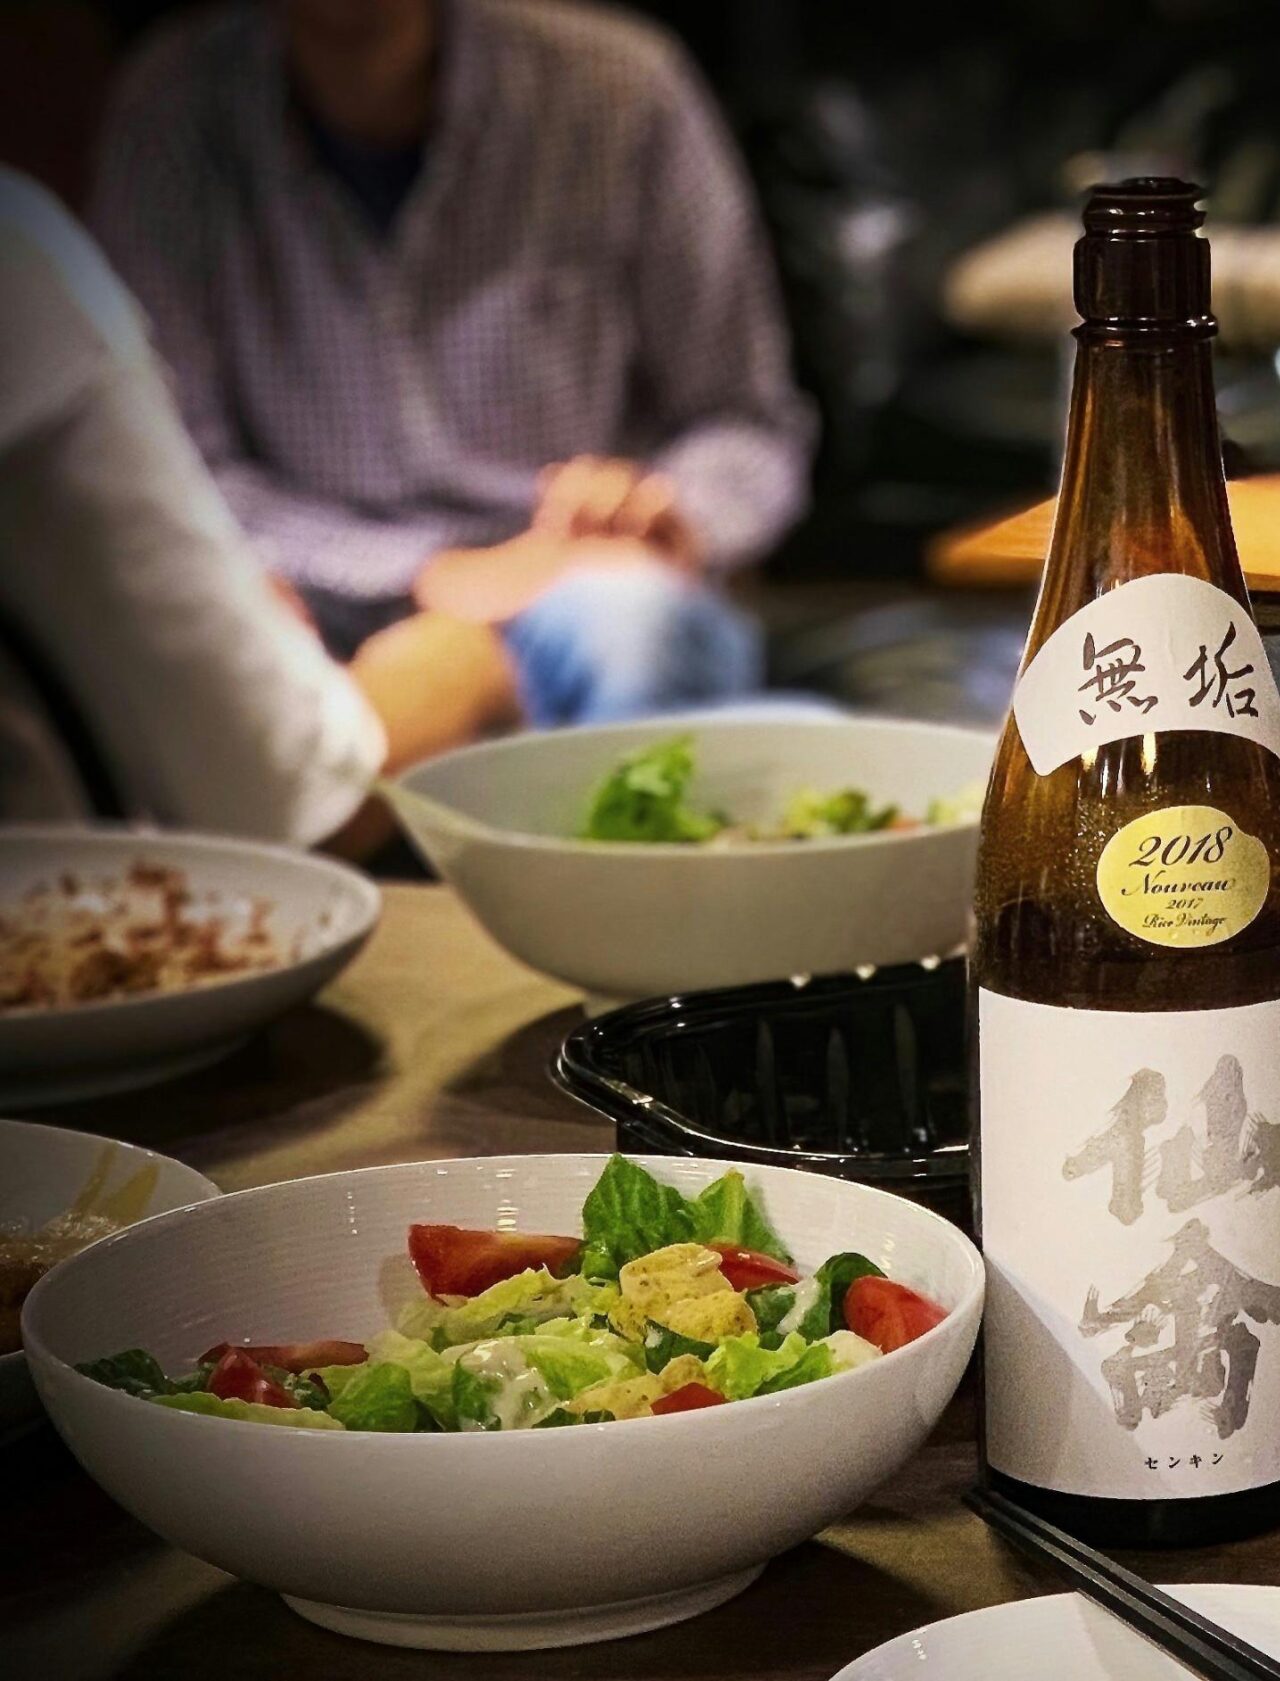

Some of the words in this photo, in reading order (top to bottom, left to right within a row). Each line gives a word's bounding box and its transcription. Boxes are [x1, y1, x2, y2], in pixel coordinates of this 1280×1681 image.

[1077, 621, 1260, 726] 無垢
[1128, 826, 1234, 868] 2018
[1121, 870, 1236, 897] Nouveau
[1164, 898, 1205, 910] 2017
[1142, 913, 1174, 929] Rice
[1176, 912, 1228, 937] Vintage
[1144, 1452, 1225, 1471] センキン
